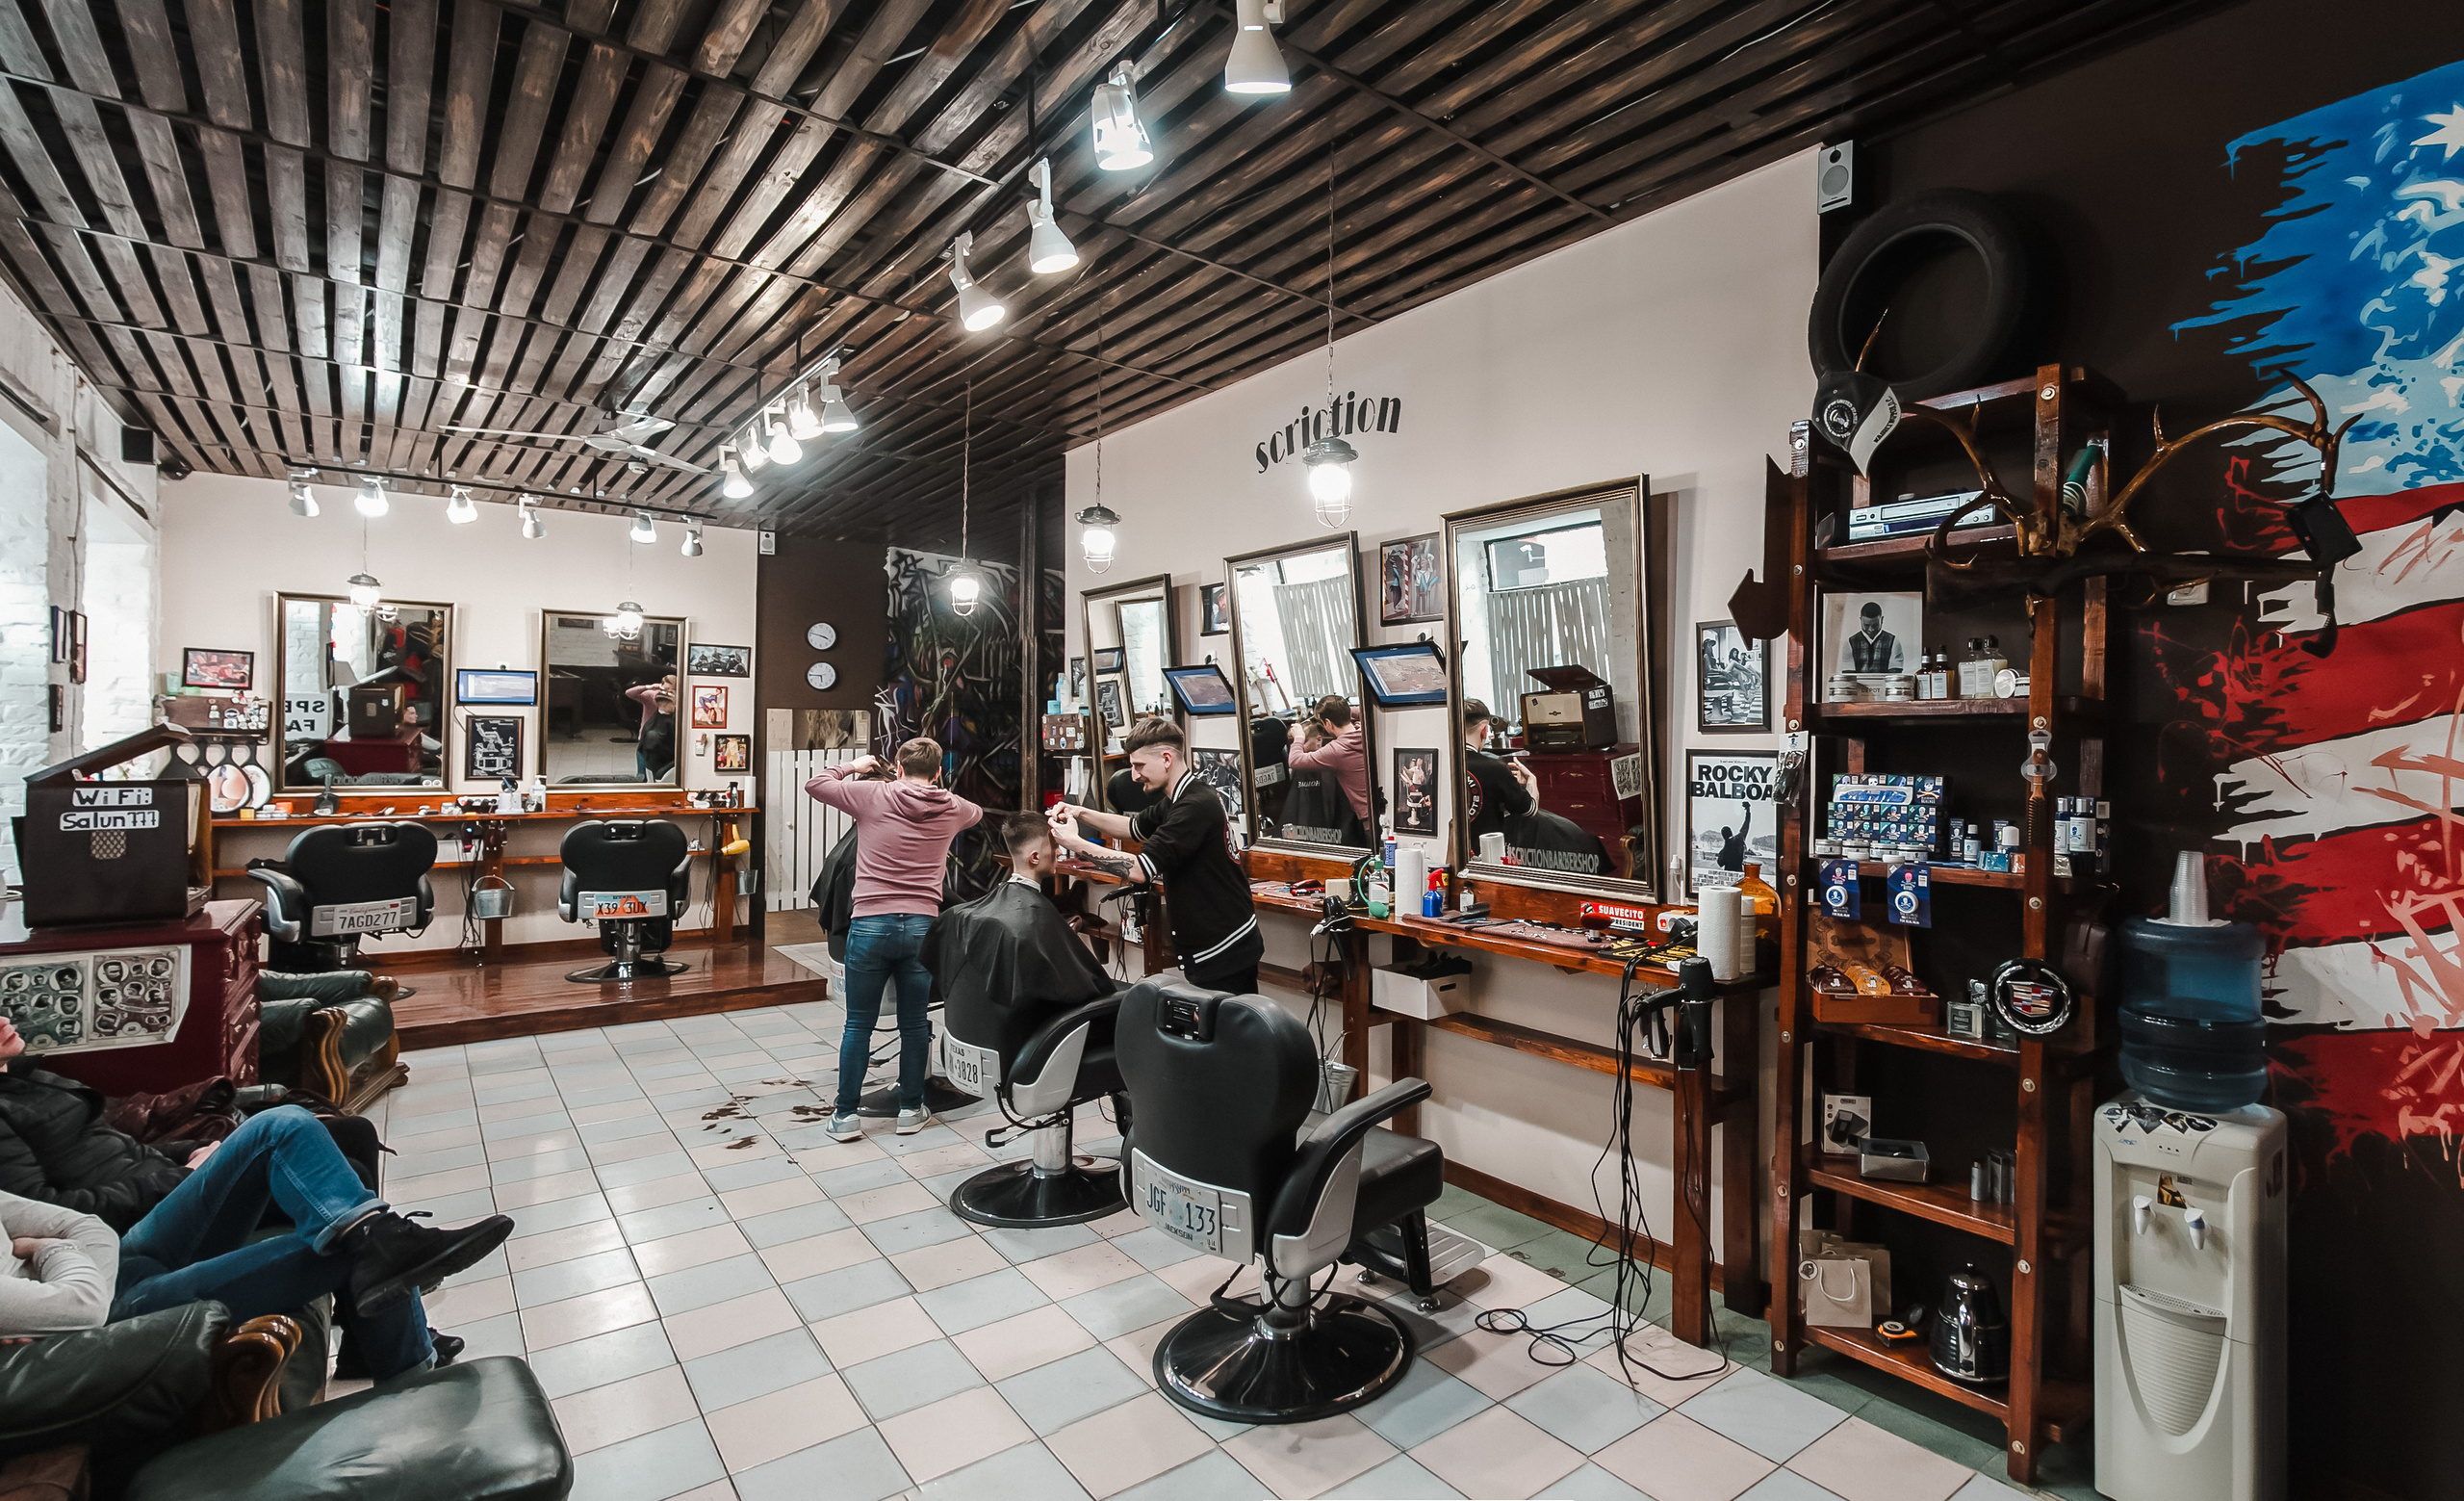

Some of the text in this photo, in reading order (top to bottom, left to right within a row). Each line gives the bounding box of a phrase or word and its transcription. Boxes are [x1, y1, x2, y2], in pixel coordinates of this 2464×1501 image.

[1255, 390, 1401, 474] scriction
[1698, 763, 1773, 784] ROCKY
[1691, 781, 1774, 801] BALBOA
[597, 901, 648, 915] X39 3UX
[1598, 905, 1644, 919] SUAVECITO
[339, 911, 397, 929] 7AGD277
[1146, 1182, 1216, 1235] JGF 133
[1164, 1222, 1194, 1241] JACKSON
